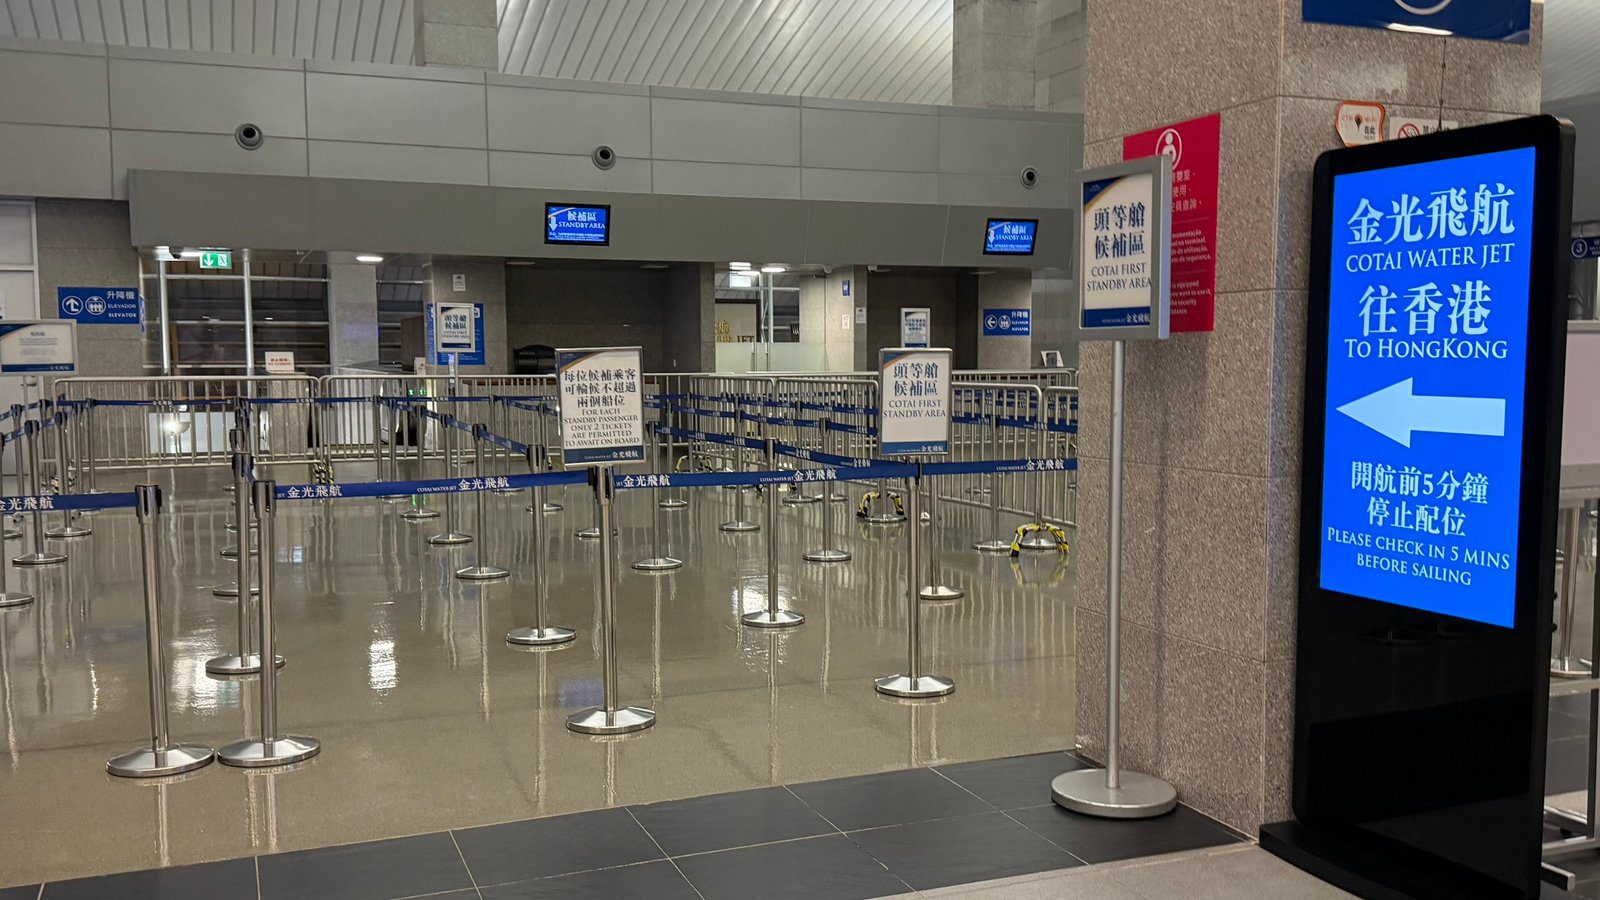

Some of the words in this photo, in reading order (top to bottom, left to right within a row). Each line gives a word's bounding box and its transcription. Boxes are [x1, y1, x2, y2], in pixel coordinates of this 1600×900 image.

[1093, 201, 1146, 231] 頭等艙
[1346, 182, 1516, 245] 金光飛航
[558, 221, 589, 229] STANDBY
[589, 222, 606, 230] AREA
[1094, 231, 1146, 260] 候補區
[1345, 251, 1402, 273] COTAI
[1407, 245, 1478, 269] WATER
[1480, 242, 1516, 270] JET
[1091, 265, 1119, 278] COTAI
[1121, 262, 1148, 275] FIRST
[1086, 279, 1127, 292] STANDBY
[1128, 276, 1152, 289] AREA
[106, 290, 135, 300] 升降機
[1358, 279, 1492, 337] 往香港
[893, 362, 939, 379] 頭等艙
[894, 380, 938, 397] 候補區
[888, 399, 916, 408] COTAI
[919, 399, 943, 408] FIRST
[582, 408, 598, 416] FOR
[599, 407, 621, 416] EACH
[883, 409, 924, 418] STANDBY
[924, 409, 947, 418] AREA
[563, 416, 598, 425] STANDBY
[598, 414, 639, 424] PASSENGER
[570, 424, 592, 432] ONLY
[594, 423, 600, 431] 2
[601, 422, 633, 431] TICKETS
[571, 431, 588, 439] ARE
[588, 430, 632, 439] PERMITTED
[565, 440, 576, 448] TO
[576, 439, 599, 447] AWAIT
[601, 438, 613, 446] ON
[614, 437, 640, 445] BOARD
[1026, 458, 1064, 471] 金光飛航
[624, 475, 671, 488] 金光飛航
[794, 467, 837, 482] 金光飛航
[459, 476, 510, 491] 金光飛航
[1351, 460, 1489, 505] 開航前5分鐘
[287, 485, 343, 499] 金光飛航
[1367, 496, 1467, 537] 停止配位
[1327, 526, 1372, 549] PLEASE
[1375, 535, 1425, 557] CHECK
[1428, 544, 1445, 560] IN
[1450, 546, 1459, 562] 5
[1463, 548, 1511, 571] MINS
[1356, 552, 1408, 575] BEFORE
[1412, 562, 1472, 586] SAILING
